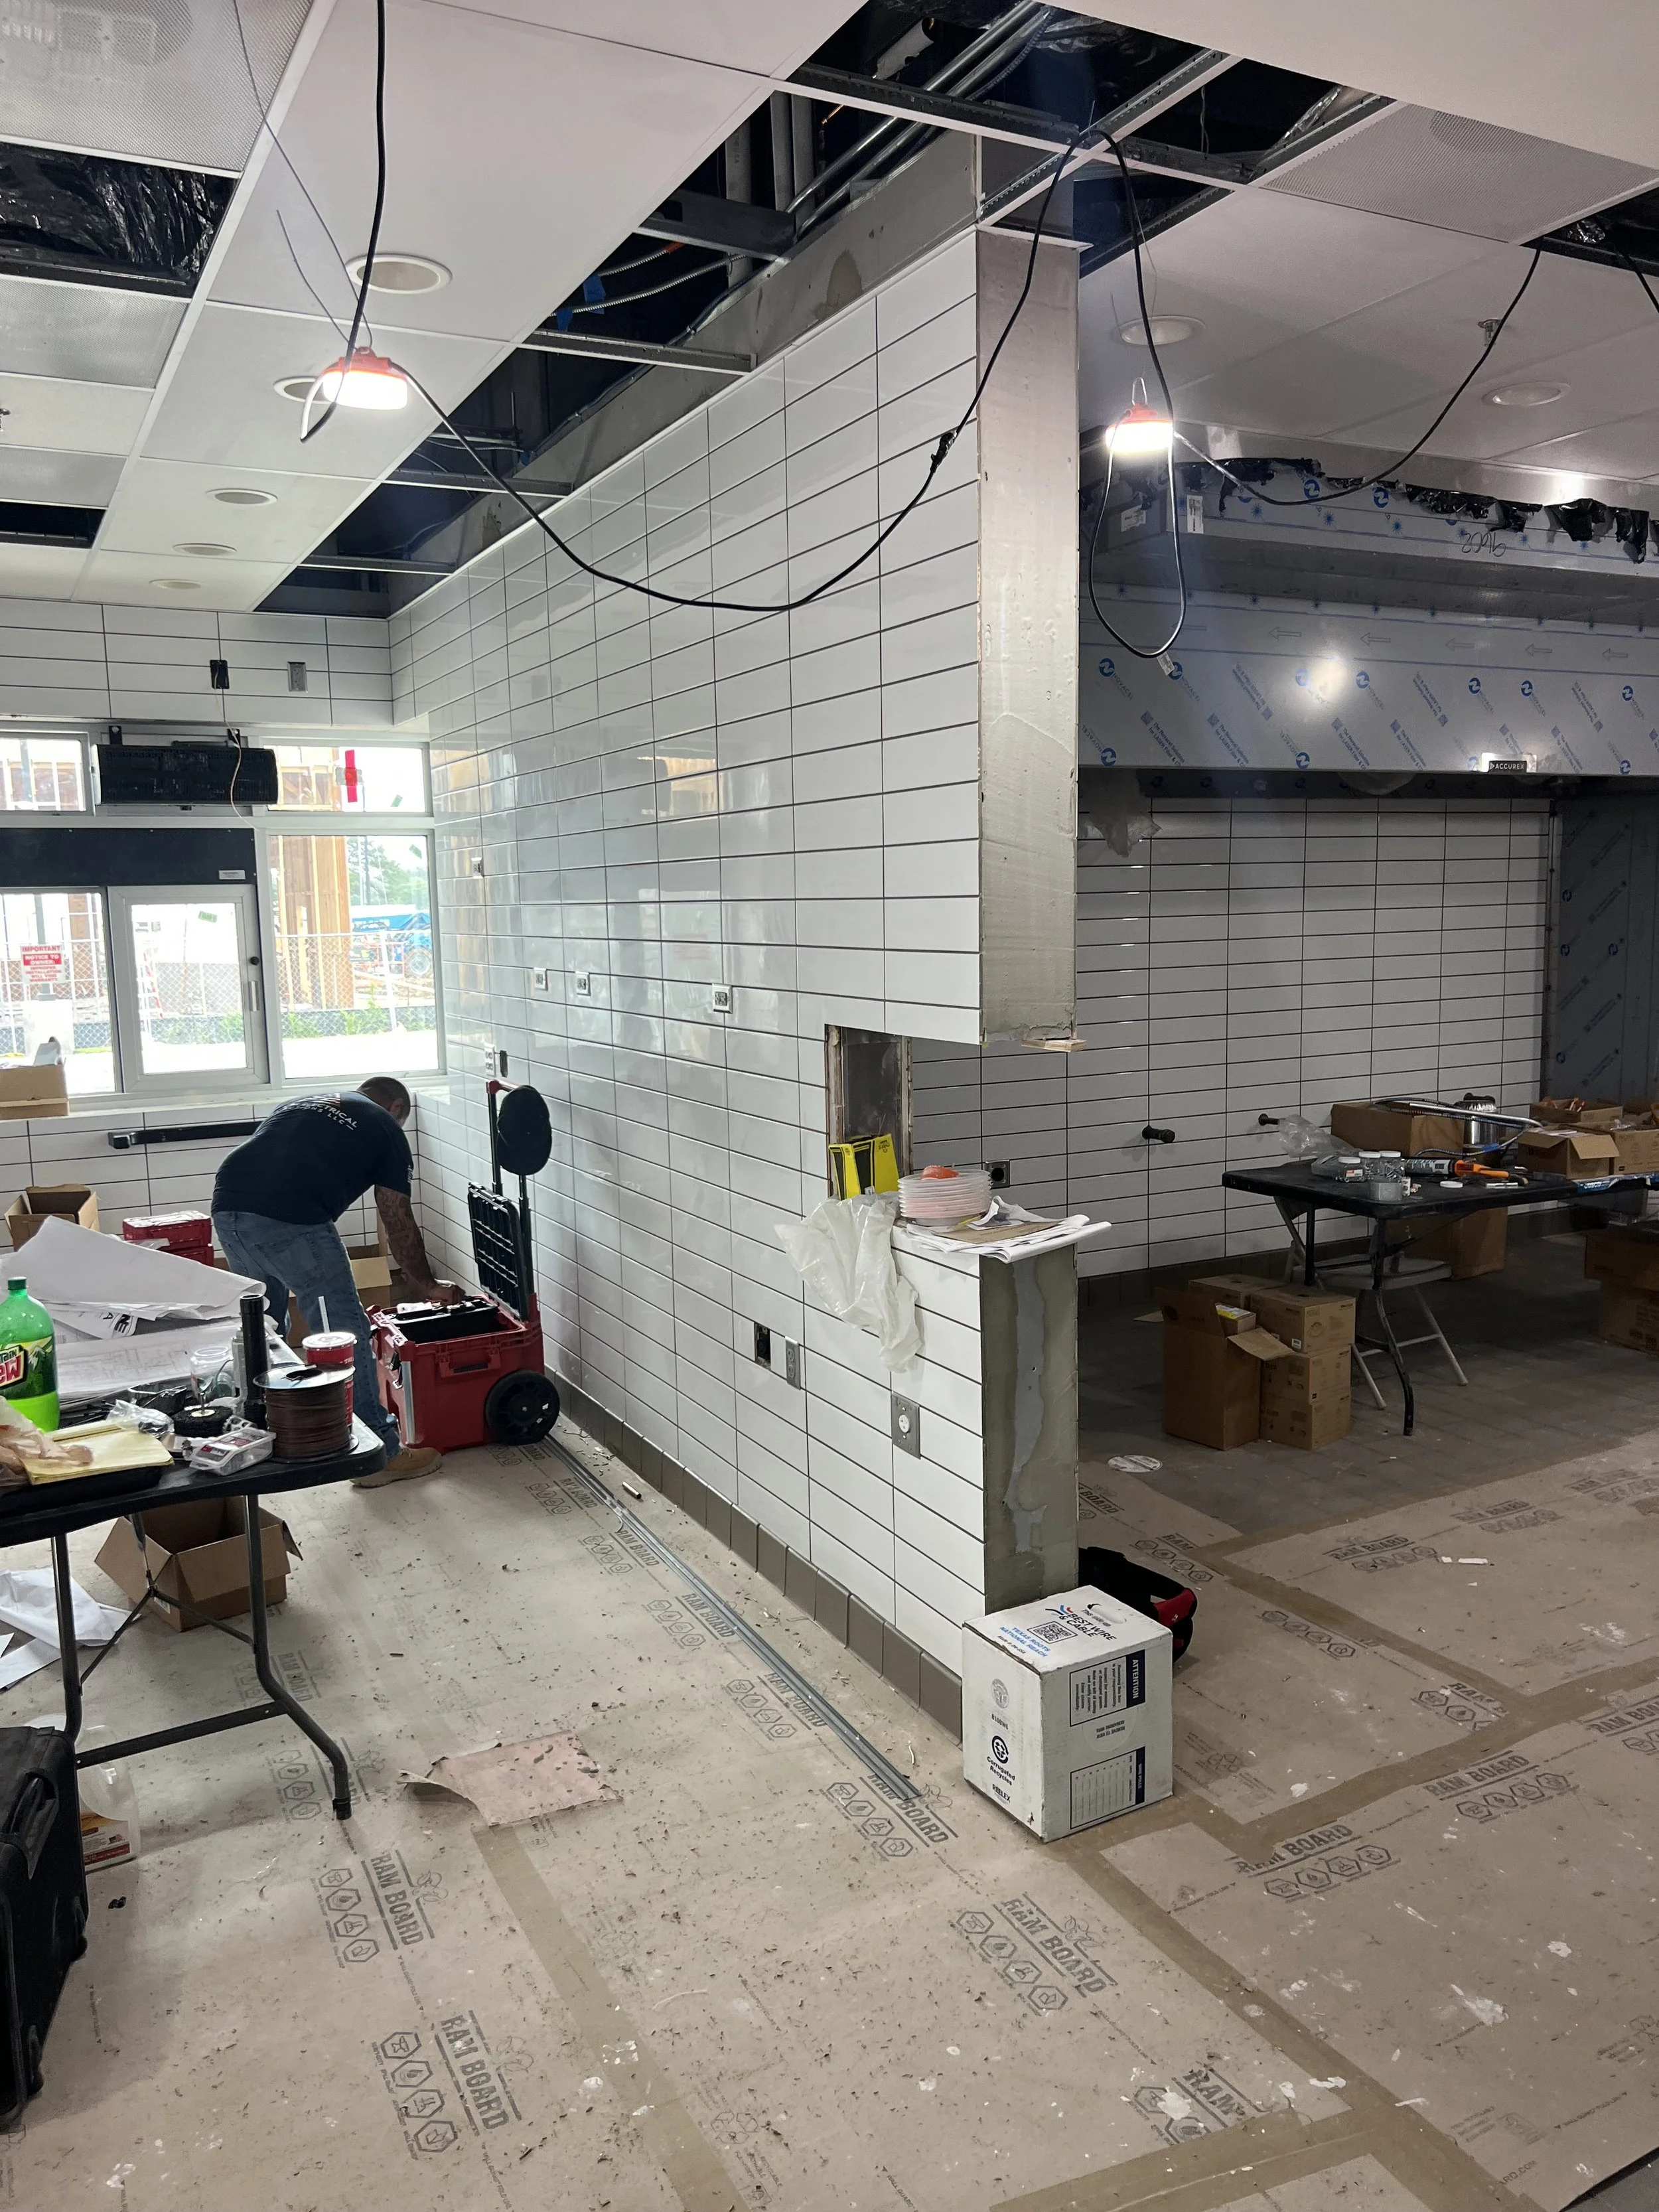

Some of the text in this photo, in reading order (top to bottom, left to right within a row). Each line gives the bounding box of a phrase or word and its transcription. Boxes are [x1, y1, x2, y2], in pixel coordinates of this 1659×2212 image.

[327, 1113, 346, 1125] LLC
[571, 1489, 597, 1507] BOARD
[629, 1544, 660, 1566] BOARD
[1329, 1536, 1409, 1558] RAM BOARD
[681, 1592, 708, 1611] RAM
[699, 1609, 735, 1637] BOARD
[1068, 1613, 1117, 1641] BEST WIRE
[999, 1627, 1047, 1657] NATIONAL REACH
[1011, 1627, 1051, 1651] TEXAS ROOTS
[1067, 1621, 1098, 1637] CABLE
[1590, 1716, 1632, 1732] RAM
[987, 1756, 1015, 1781] Corrugated
[990, 1765, 1013, 1786] Recycles
[1422, 1755, 1530, 1795] RAM BOARD
[992, 1783, 1010, 1803] REELEX
[895, 1798, 949, 1843] BOARD
[1281, 1822, 1353, 1856] BOARD
[370, 1853, 425, 1945] RAM BOARD
[1002, 1897, 1048, 1937] RAM
[1040, 1935, 1108, 1994] BOARD
[439, 2014, 511, 2130] RAM BOARD
[1182, 2067, 1238, 2115] RAM
